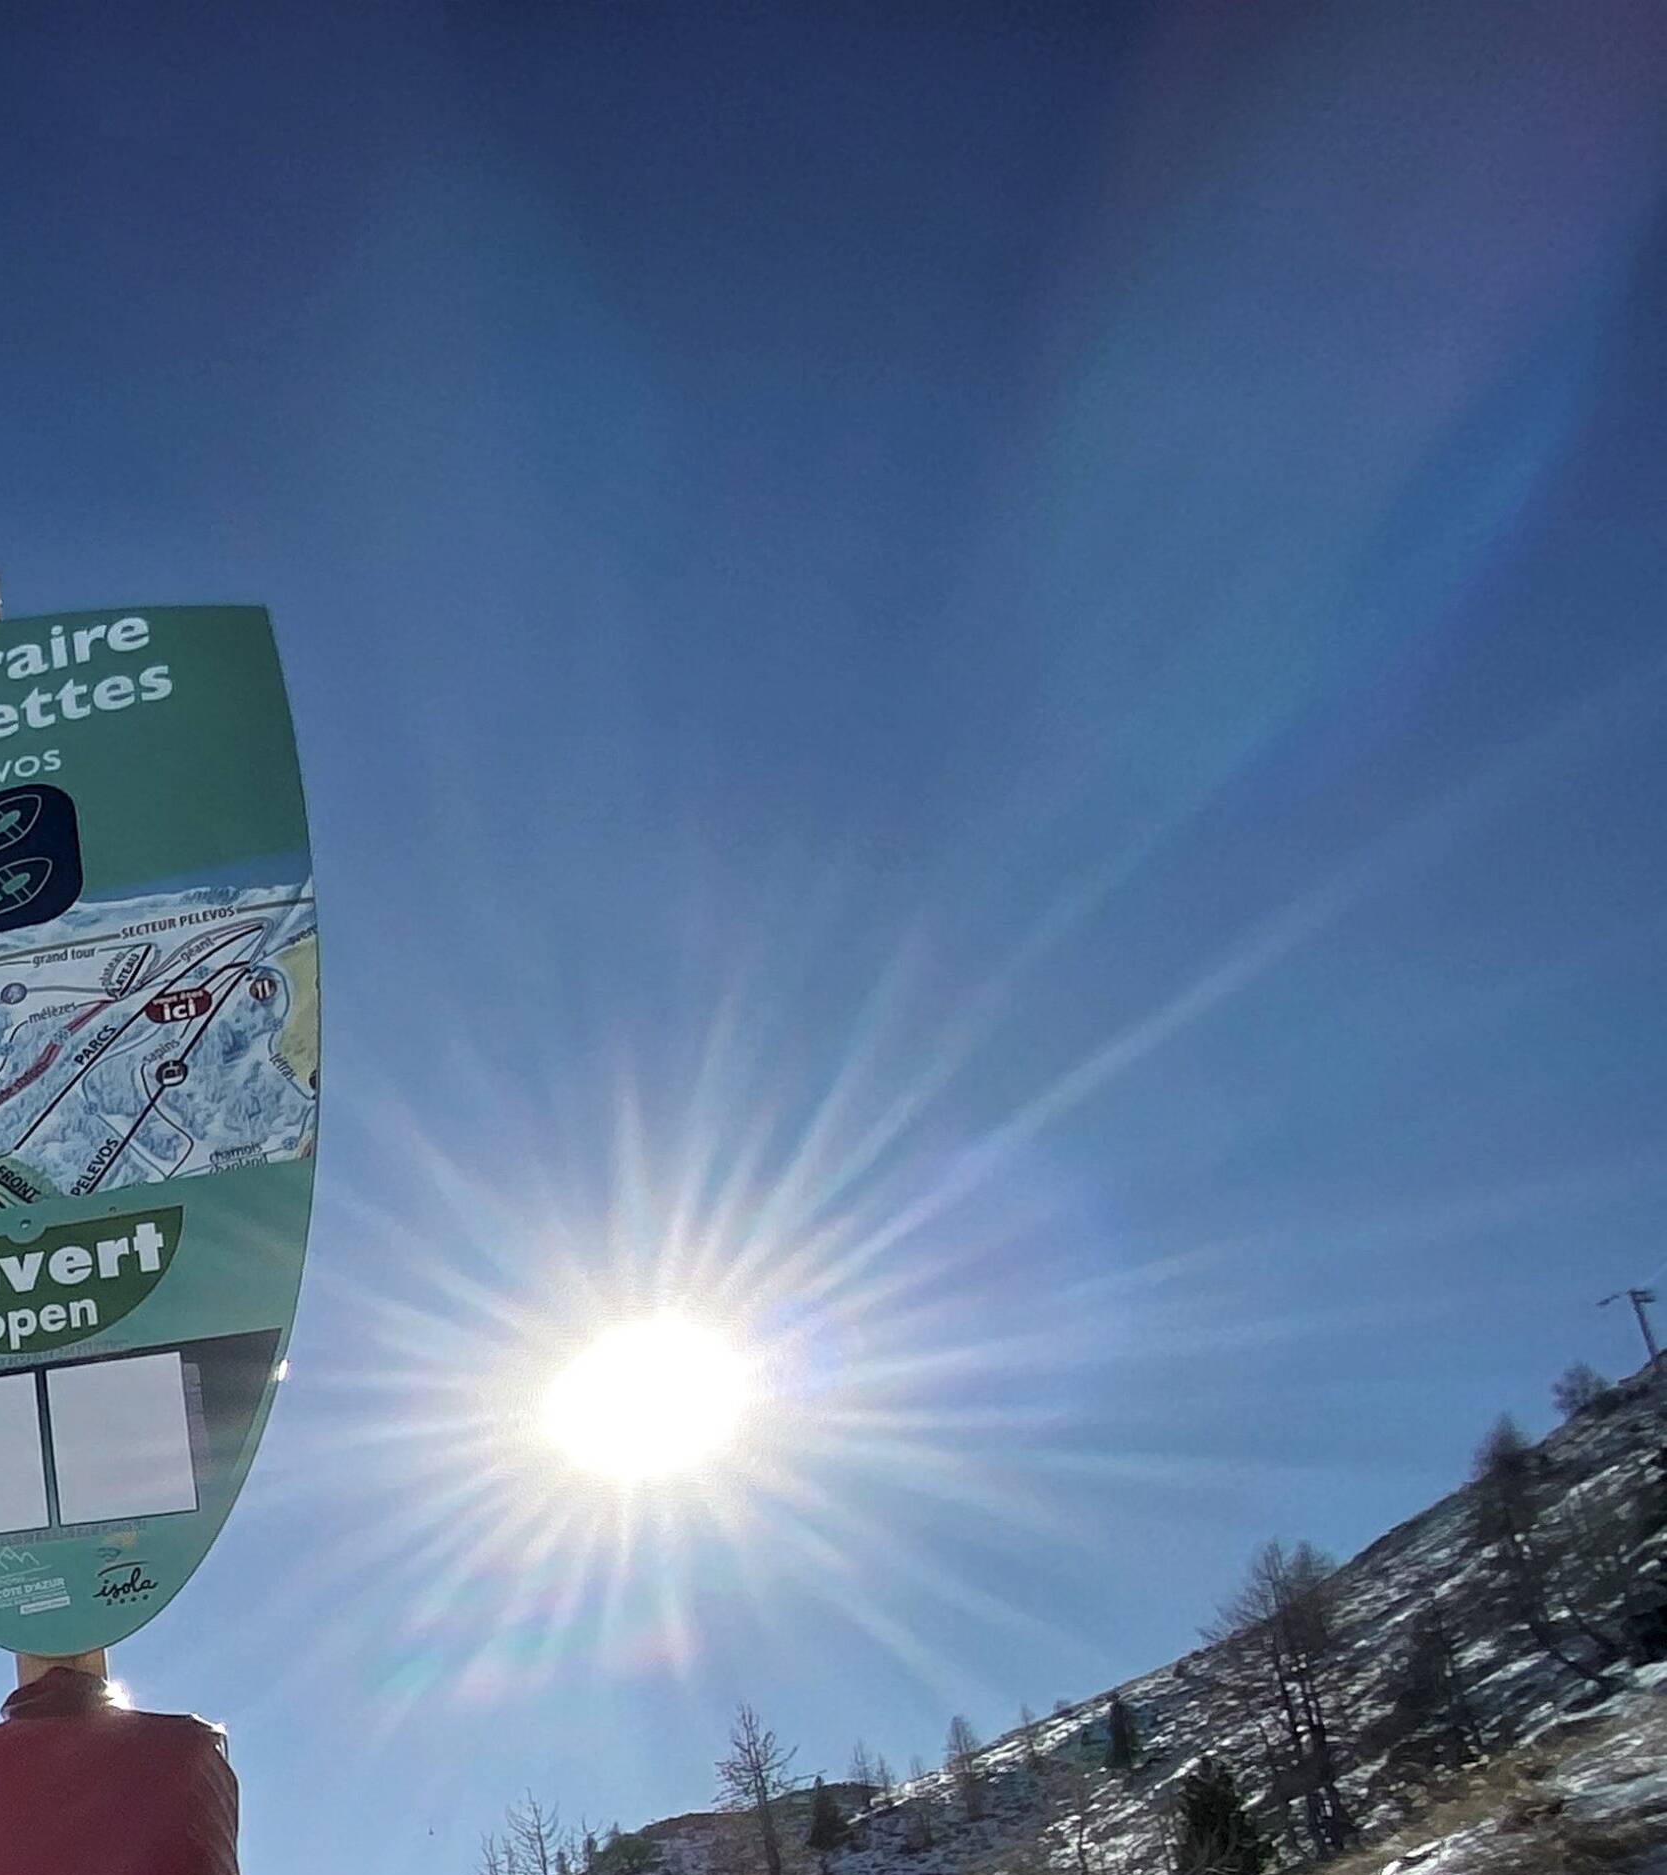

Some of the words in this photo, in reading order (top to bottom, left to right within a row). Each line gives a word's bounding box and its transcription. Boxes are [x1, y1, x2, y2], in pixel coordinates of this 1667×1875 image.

[121, 917, 177, 939] SECTEUR
[179, 905, 235, 926] PELEVOS
[32, 950, 69, 968] grand
[71, 947, 97, 961] tour
[180, 937, 216, 963] géant
[28, 1001, 78, 1023] mélèzes
[163, 998, 197, 1021] ici
[74, 1023, 118, 1066] PARCS
[143, 1038, 181, 1065] sapins
[209, 1140, 263, 1164] chamois
[70, 1136, 119, 1197] PELEVOS
[25, 1577, 66, 1593] D'AZUR
[93, 1567, 159, 1599] isola
